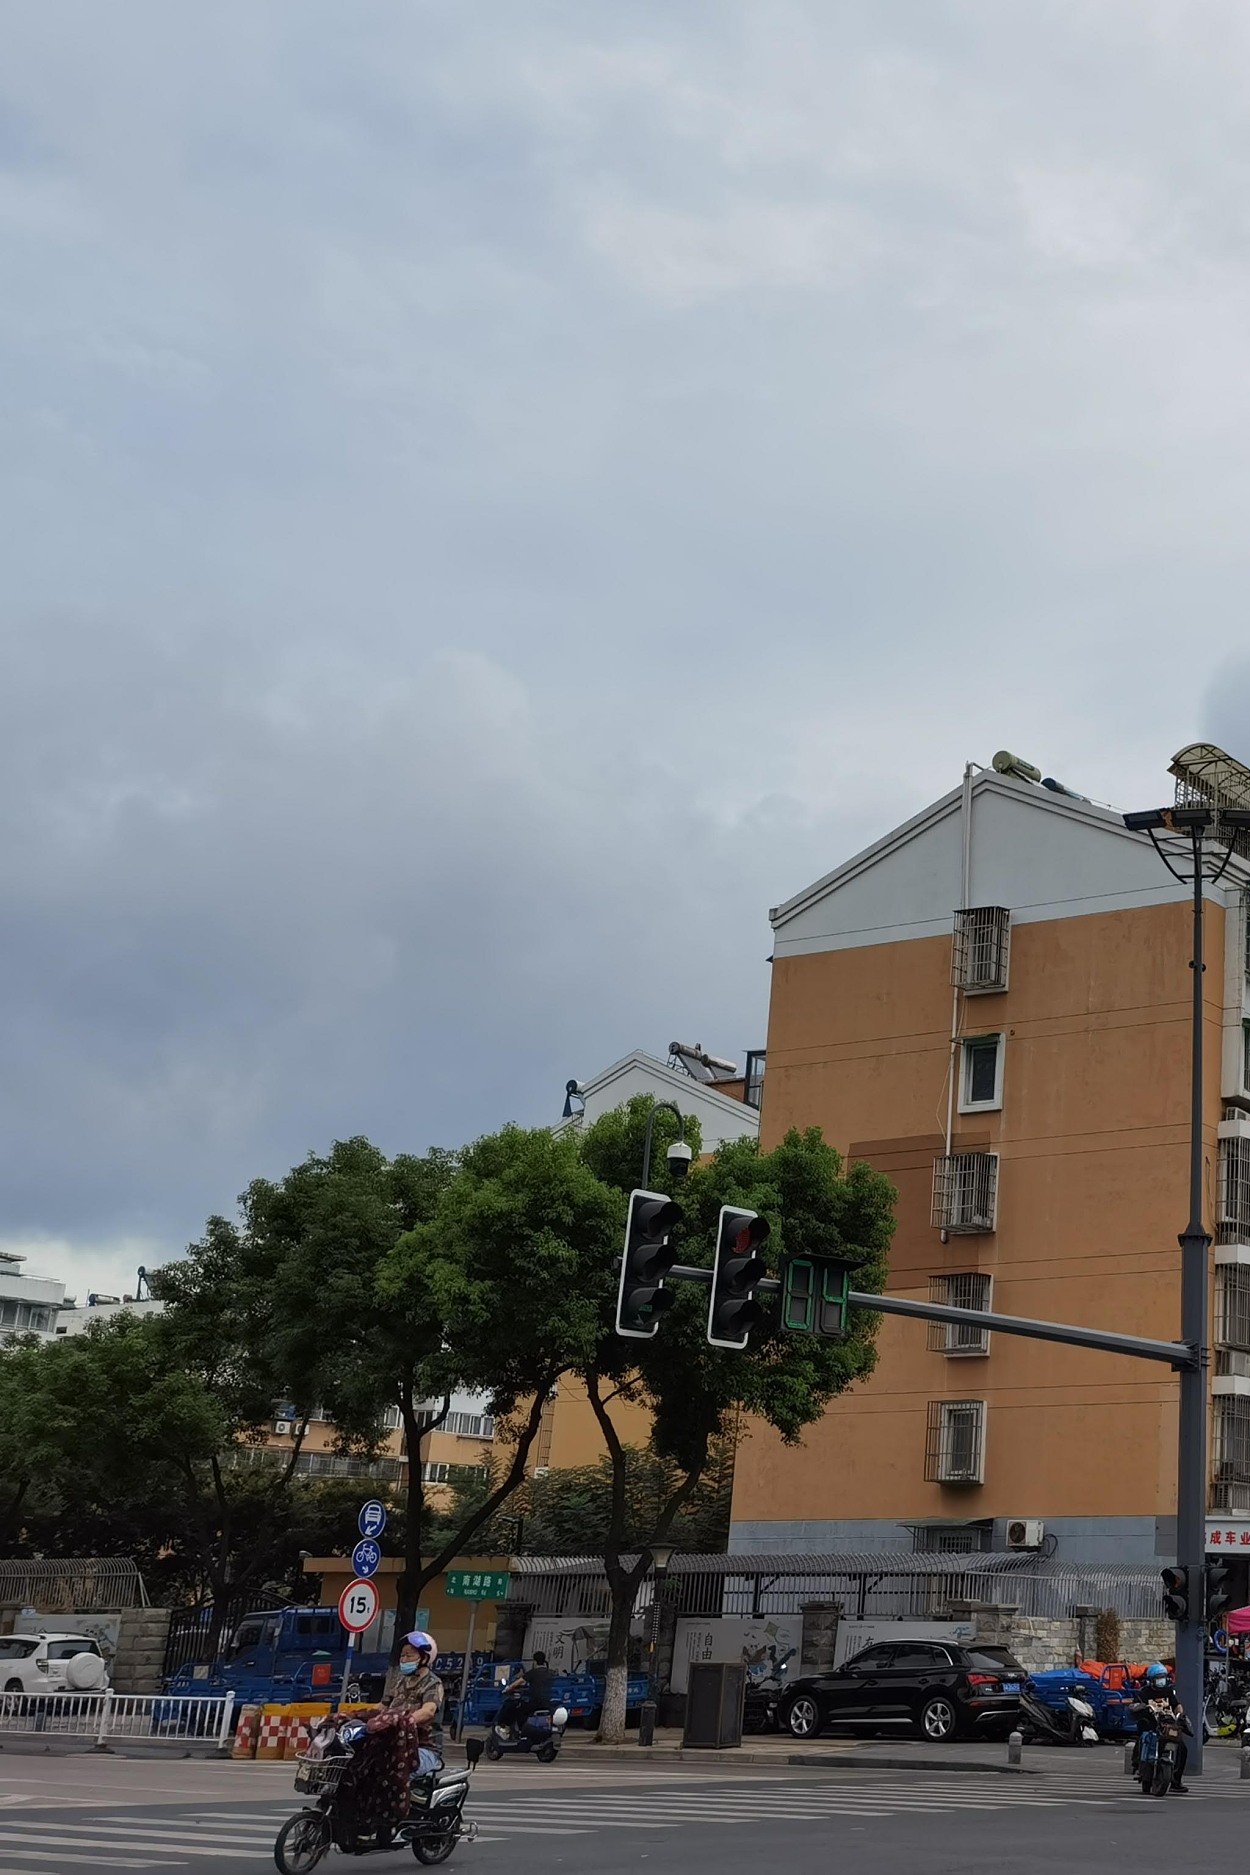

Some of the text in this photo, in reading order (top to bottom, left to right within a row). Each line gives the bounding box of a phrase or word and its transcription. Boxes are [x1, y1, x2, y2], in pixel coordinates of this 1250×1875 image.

[462, 1575, 492, 1587] 南湖路
[552, 1632, 566, 1660] 文明
[702, 1632, 713, 1660] 自由
